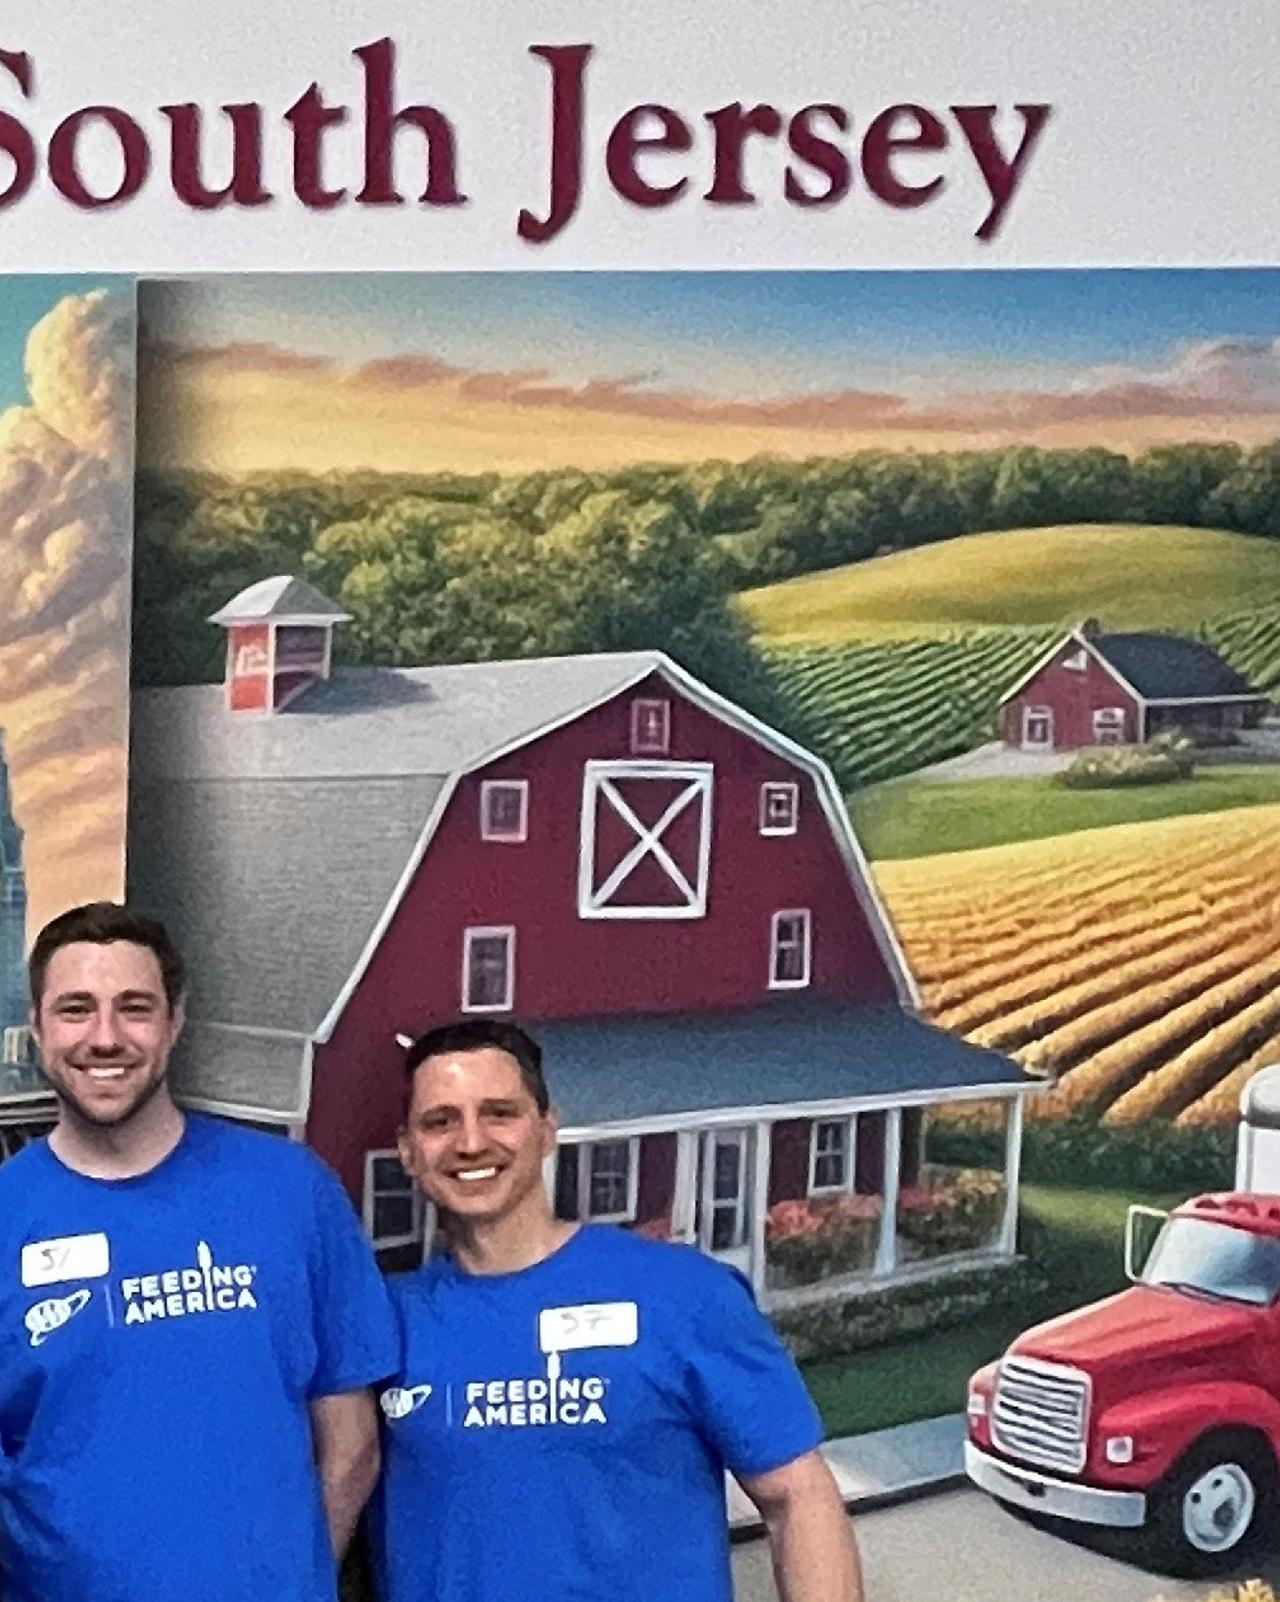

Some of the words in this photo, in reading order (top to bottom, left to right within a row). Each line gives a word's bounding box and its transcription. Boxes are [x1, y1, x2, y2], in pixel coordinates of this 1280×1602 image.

[517, 43, 1052, 246] Jersey
[122, 1264, 253, 1301] FEEDING
[124, 1287, 257, 1326] AMERICA
[466, 1378, 605, 1404] FEEDING
[464, 1402, 607, 1428] AMERICA
